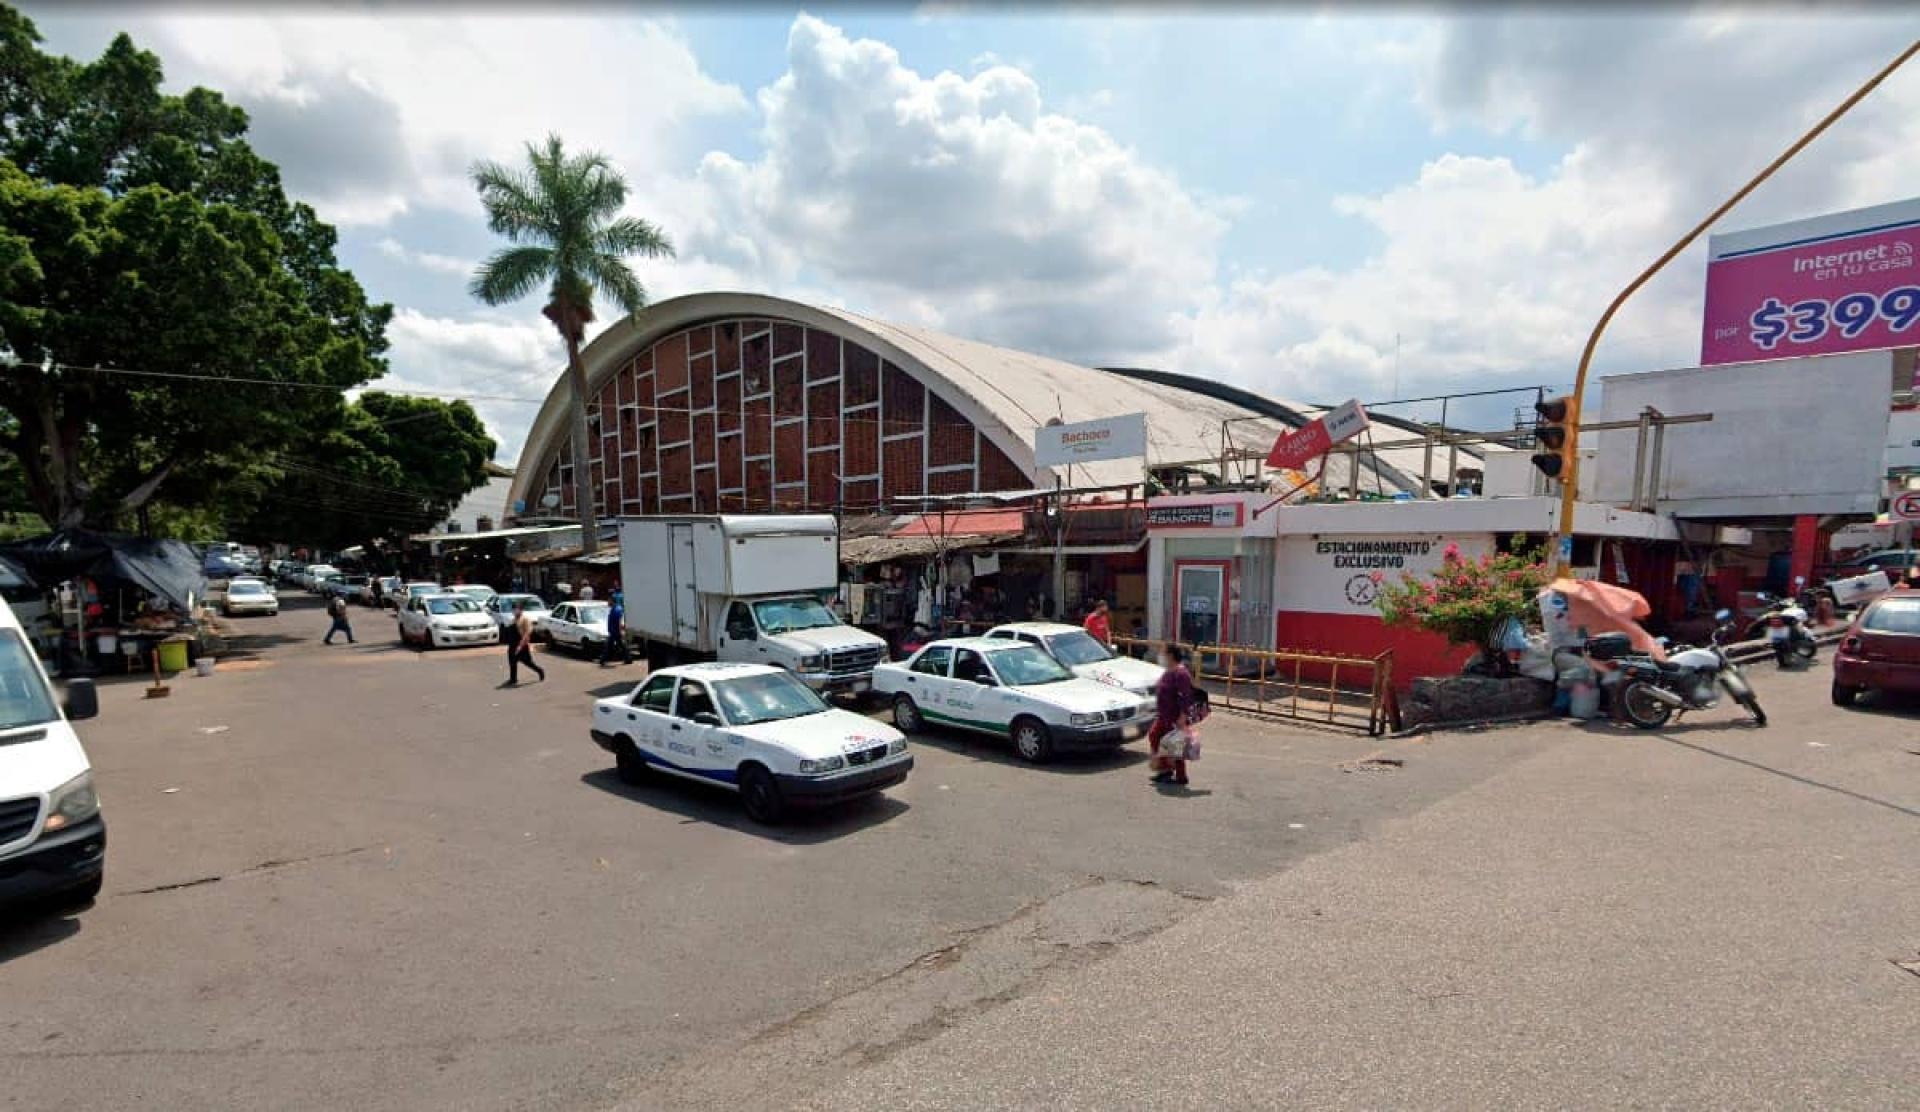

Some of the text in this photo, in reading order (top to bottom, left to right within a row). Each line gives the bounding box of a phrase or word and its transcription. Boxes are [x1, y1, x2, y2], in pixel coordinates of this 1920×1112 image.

[1793, 244, 1888, 273] Internet
[1814, 255, 1913, 281] en tu casa
[1714, 286, 1920, 350] por $399
[1062, 430, 1111, 444] Bachoco
[1317, 541, 1430, 555] ESTACIONAMIENTO
[1334, 555, 1404, 569] EXCLUSIVO
